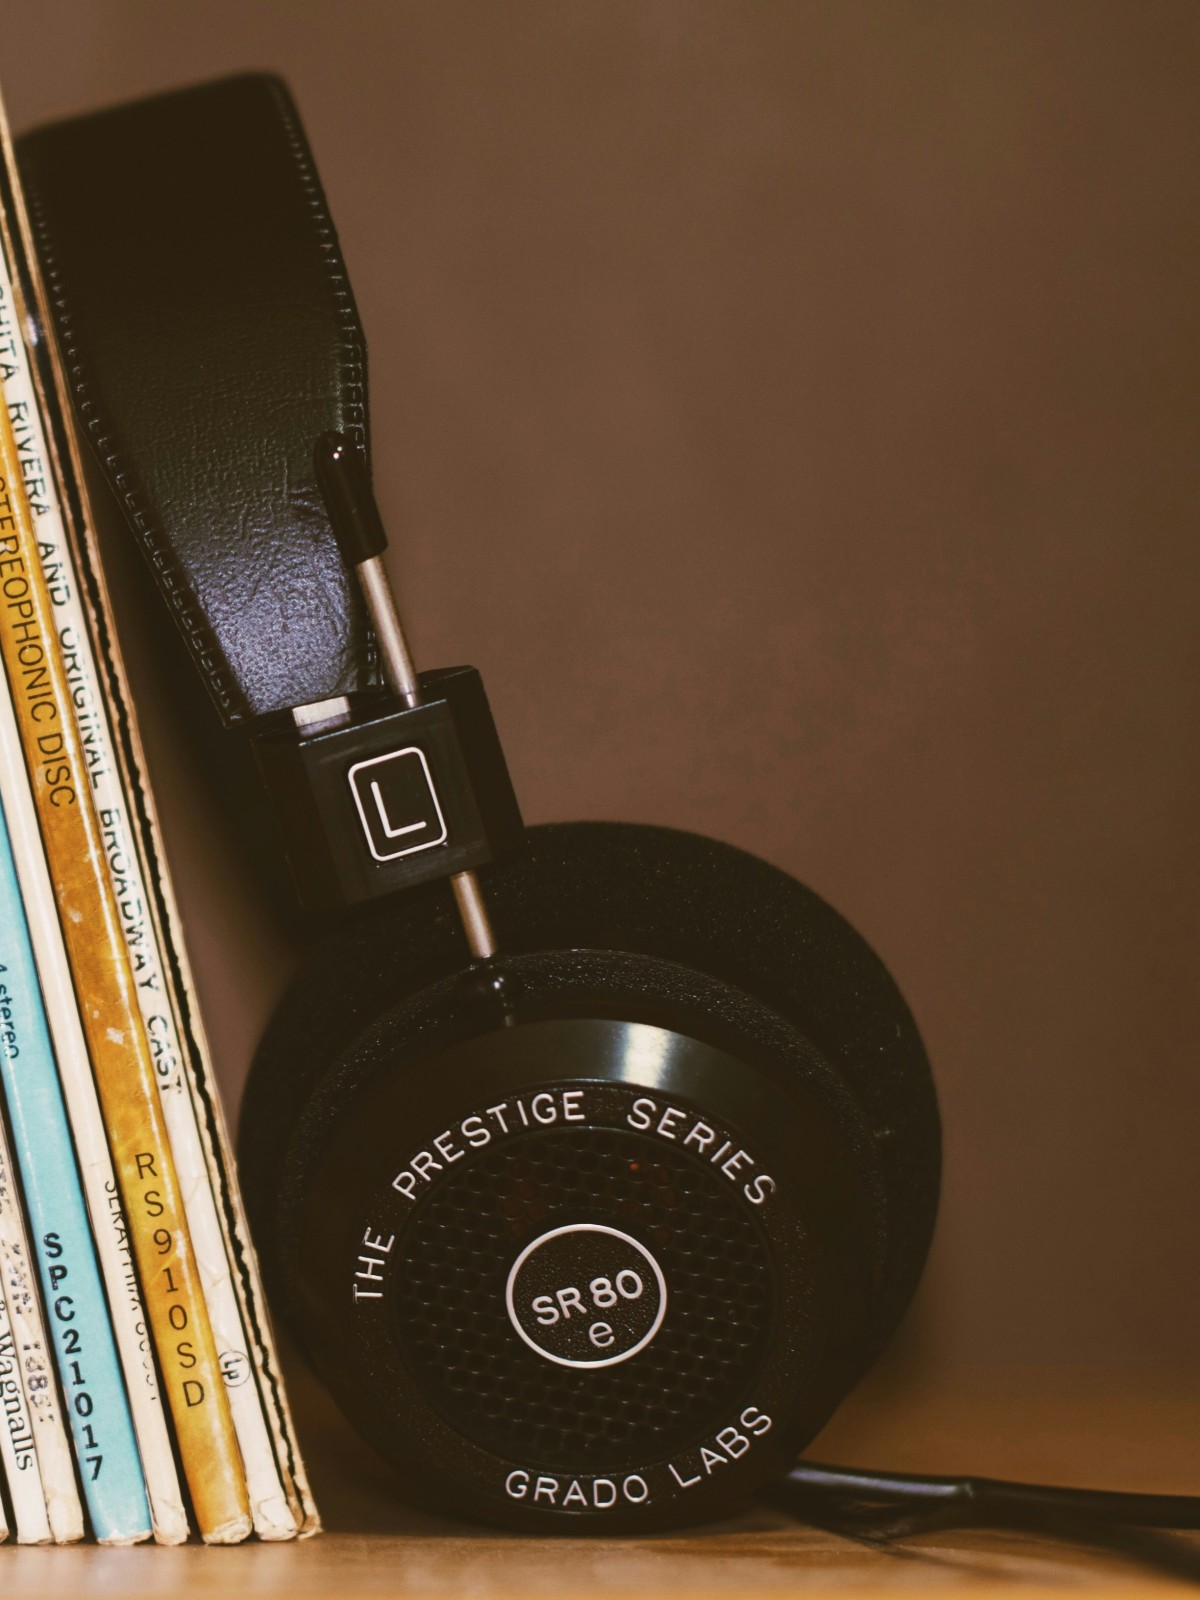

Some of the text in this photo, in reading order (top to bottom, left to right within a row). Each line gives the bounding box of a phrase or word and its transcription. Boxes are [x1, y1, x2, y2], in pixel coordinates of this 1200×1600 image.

[8, 402, 50, 517] RIVERA
[37, 541, 71, 607] AND
[59, 626, 110, 790] ORIGINAL
[99, 808, 160, 992] BROADWAY
[146, 1015, 184, 1092] CAST
[35, 732, 76, 808] DISC
[370, 780, 427, 839] L
[353, 1090, 776, 1304] THE PRESTIGE SERIES
[588, 1320, 616, 1348] e
[504, 1406, 772, 1508] GRADO LABS
